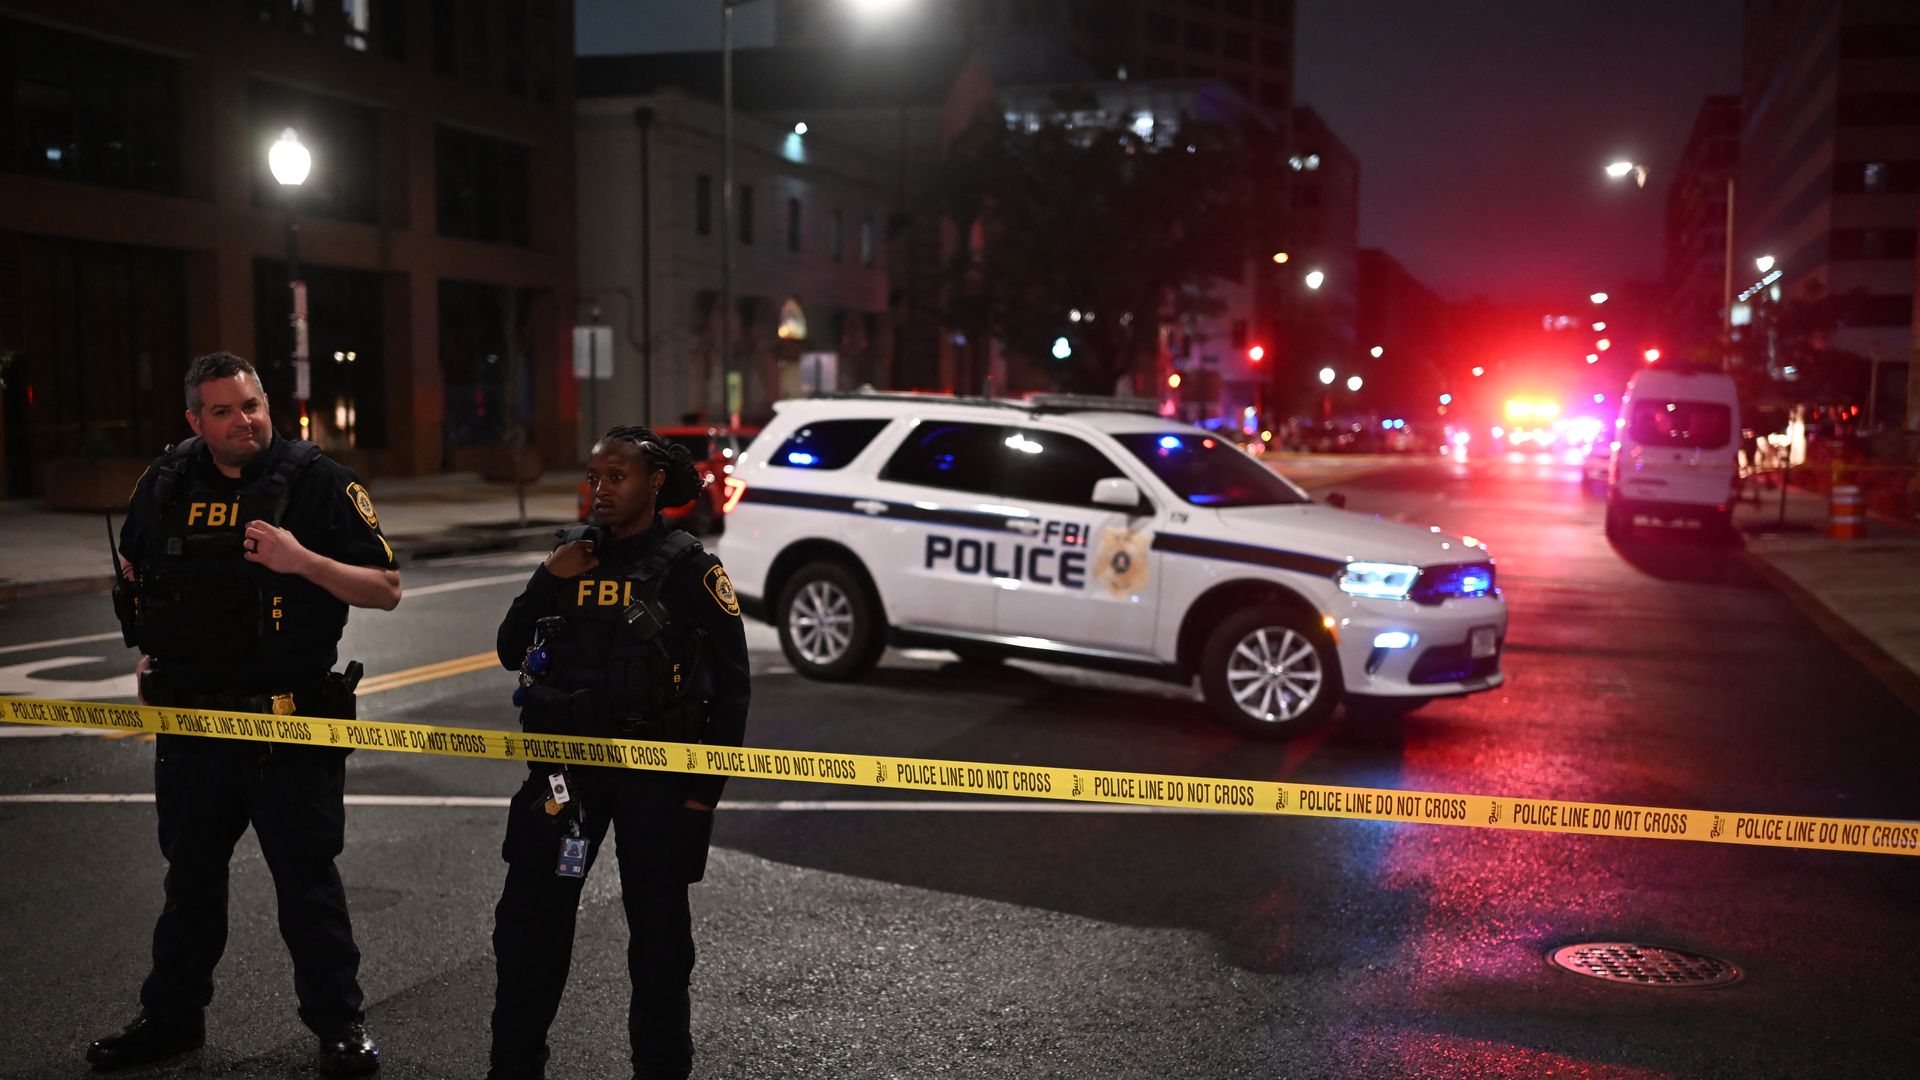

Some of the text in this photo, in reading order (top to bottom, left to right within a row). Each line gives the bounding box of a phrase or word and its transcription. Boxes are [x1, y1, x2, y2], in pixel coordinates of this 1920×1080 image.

[188, 502, 239, 526] FBI
[1043, 520, 1090, 548] FBI
[925, 534, 1086, 590] POLICE
[578, 580, 632, 606] FBI
[272, 596, 282, 630] FBI
[11, 702, 48, 720] POLICE
[48, 704, 72, 722] LINE
[70, 706, 87, 724] DO
[86, 708, 108, 726] NOT
[108, 709, 144, 728] CROSS
[176, 714, 213, 734] POLICE
[212, 717, 238, 735] LINE
[237, 718, 254, 737] DO
[253, 719, 276, 738] NOT
[276, 720, 312, 741] CROSS
[346, 726, 384, 746] POLICE
[384, 729, 409, 748] LINE
[410, 730, 426, 750] DO
[426, 732, 449, 750] NOT
[450, 733, 486, 754] CROSS
[522, 738, 561, 759] POLICE
[562, 741, 587, 760] LINE
[588, 743, 605, 762] DO
[605, 744, 628, 764] NOT
[630, 746, 668, 766] CROSS
[706, 750, 746, 772] POLICE
[748, 754, 772, 774] LINE
[774, 756, 791, 776] DO
[793, 756, 815, 776] NOT
[818, 758, 856, 780] CROSS
[896, 764, 937, 785] POLICE
[939, 766, 965, 787] LINE
[968, 768, 984, 788] DO
[987, 769, 1010, 790] NOT
[1013, 770, 1052, 793] CROSS
[1094, 776, 1135, 798] POLICE
[1138, 780, 1164, 800] LINE
[1168, 782, 1184, 802] DO
[1188, 783, 1211, 803] NOT
[1214, 784, 1254, 806] CROSS
[1300, 790, 1342, 812] POLICE
[1346, 793, 1372, 814] LINE
[1376, 795, 1393, 816] DO
[1396, 796, 1422, 817] NOT
[1425, 798, 1467, 820] CROSS
[1513, 804, 1558, 826] POLICE
[1561, 806, 1590, 828] LINE
[1592, 808, 1612, 830] DO
[1614, 810, 1642, 831] NOT
[1644, 812, 1688, 834] CROSS
[1736, 818, 1783, 840] POLICE
[1786, 820, 1817, 842] LINE
[1819, 822, 1839, 844] DO
[1842, 824, 1870, 846] NOT
[1872, 826, 1920, 850] CROSS
